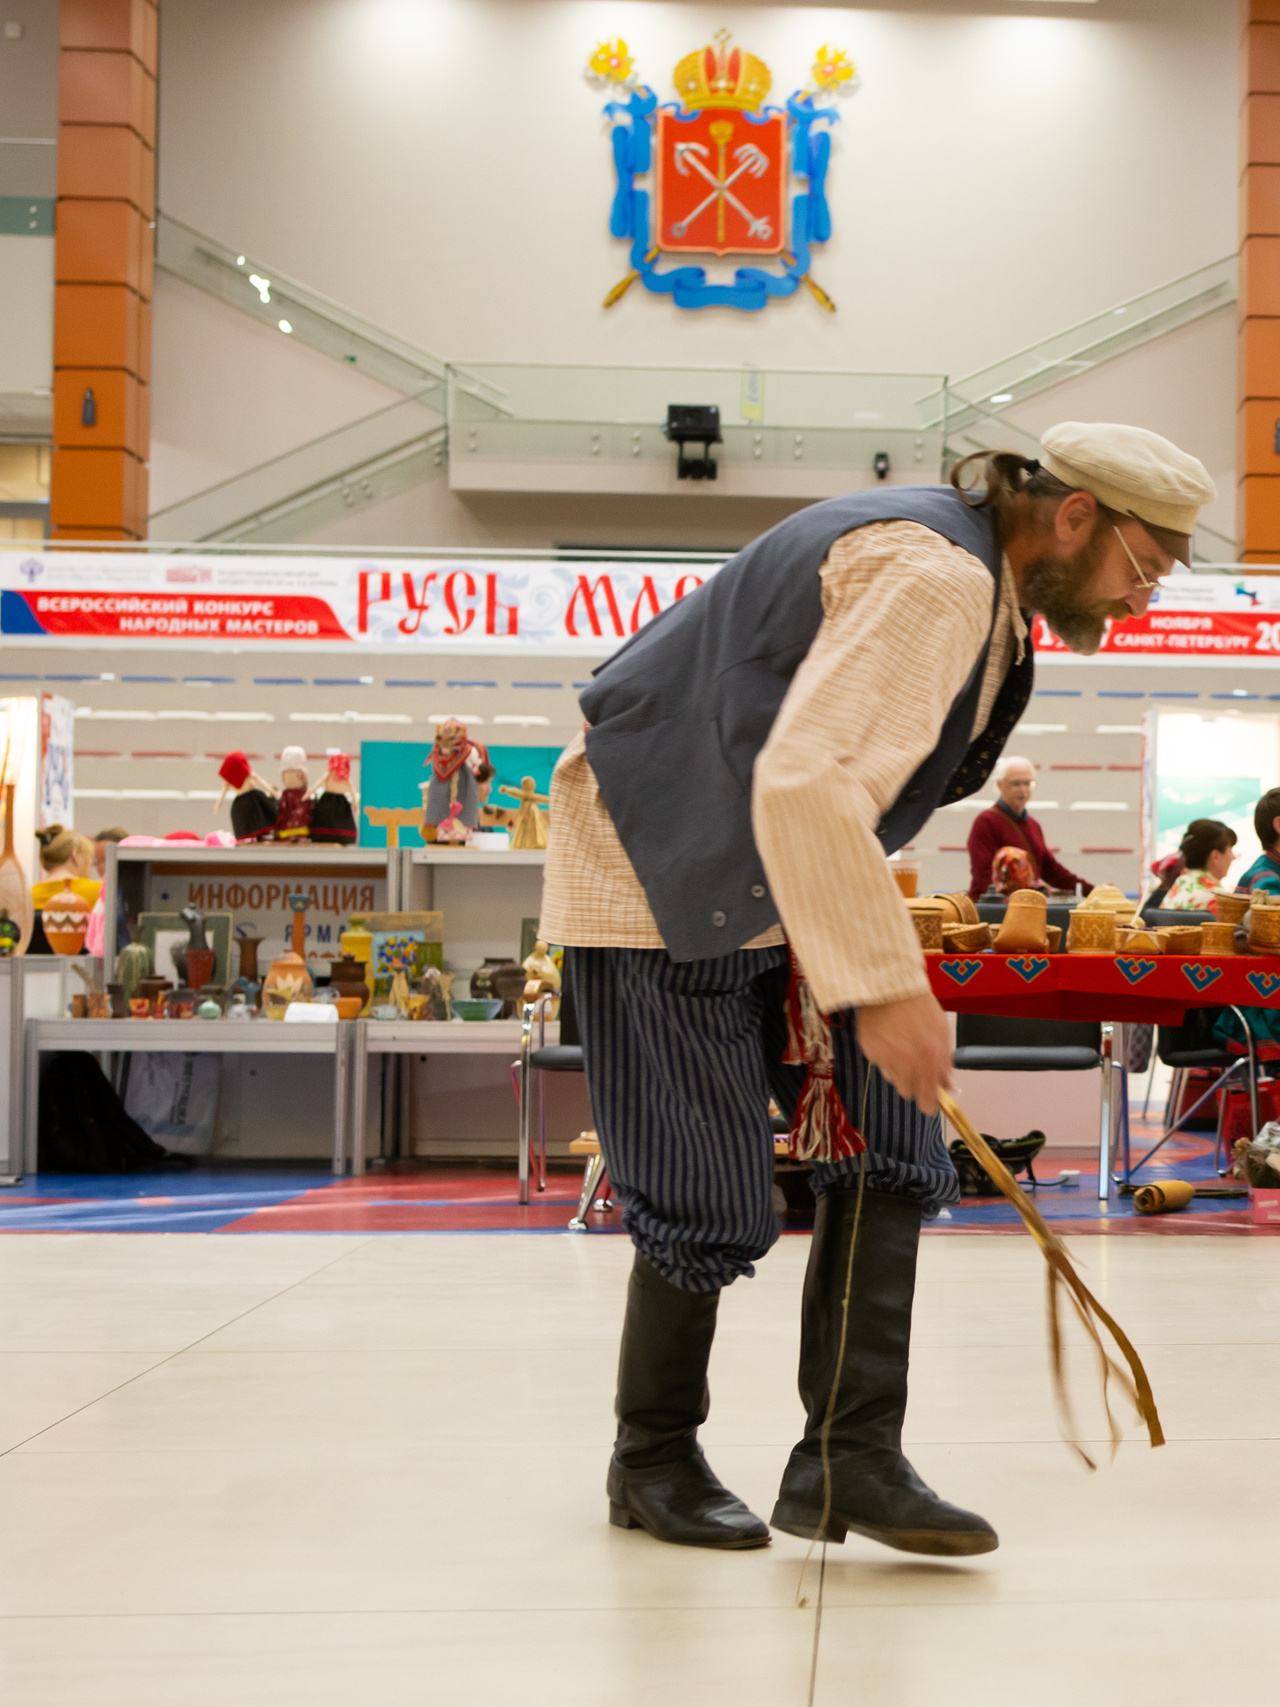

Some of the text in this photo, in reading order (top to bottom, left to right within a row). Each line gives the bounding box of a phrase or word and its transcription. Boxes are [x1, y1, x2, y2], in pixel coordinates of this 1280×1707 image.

[37, 597, 274, 616] ВСЕРОССИЙСКИЙ КОНКУРС
[357, 571, 519, 635] РУСЬ
[120, 617, 318, 634] НАРОДНЫХ МАСТЕРОВ
[1151, 616, 1212, 630] НОЯБРЯ
[1113, 632, 1251, 649] САНКТ-ПЕТЕРБУРГ
